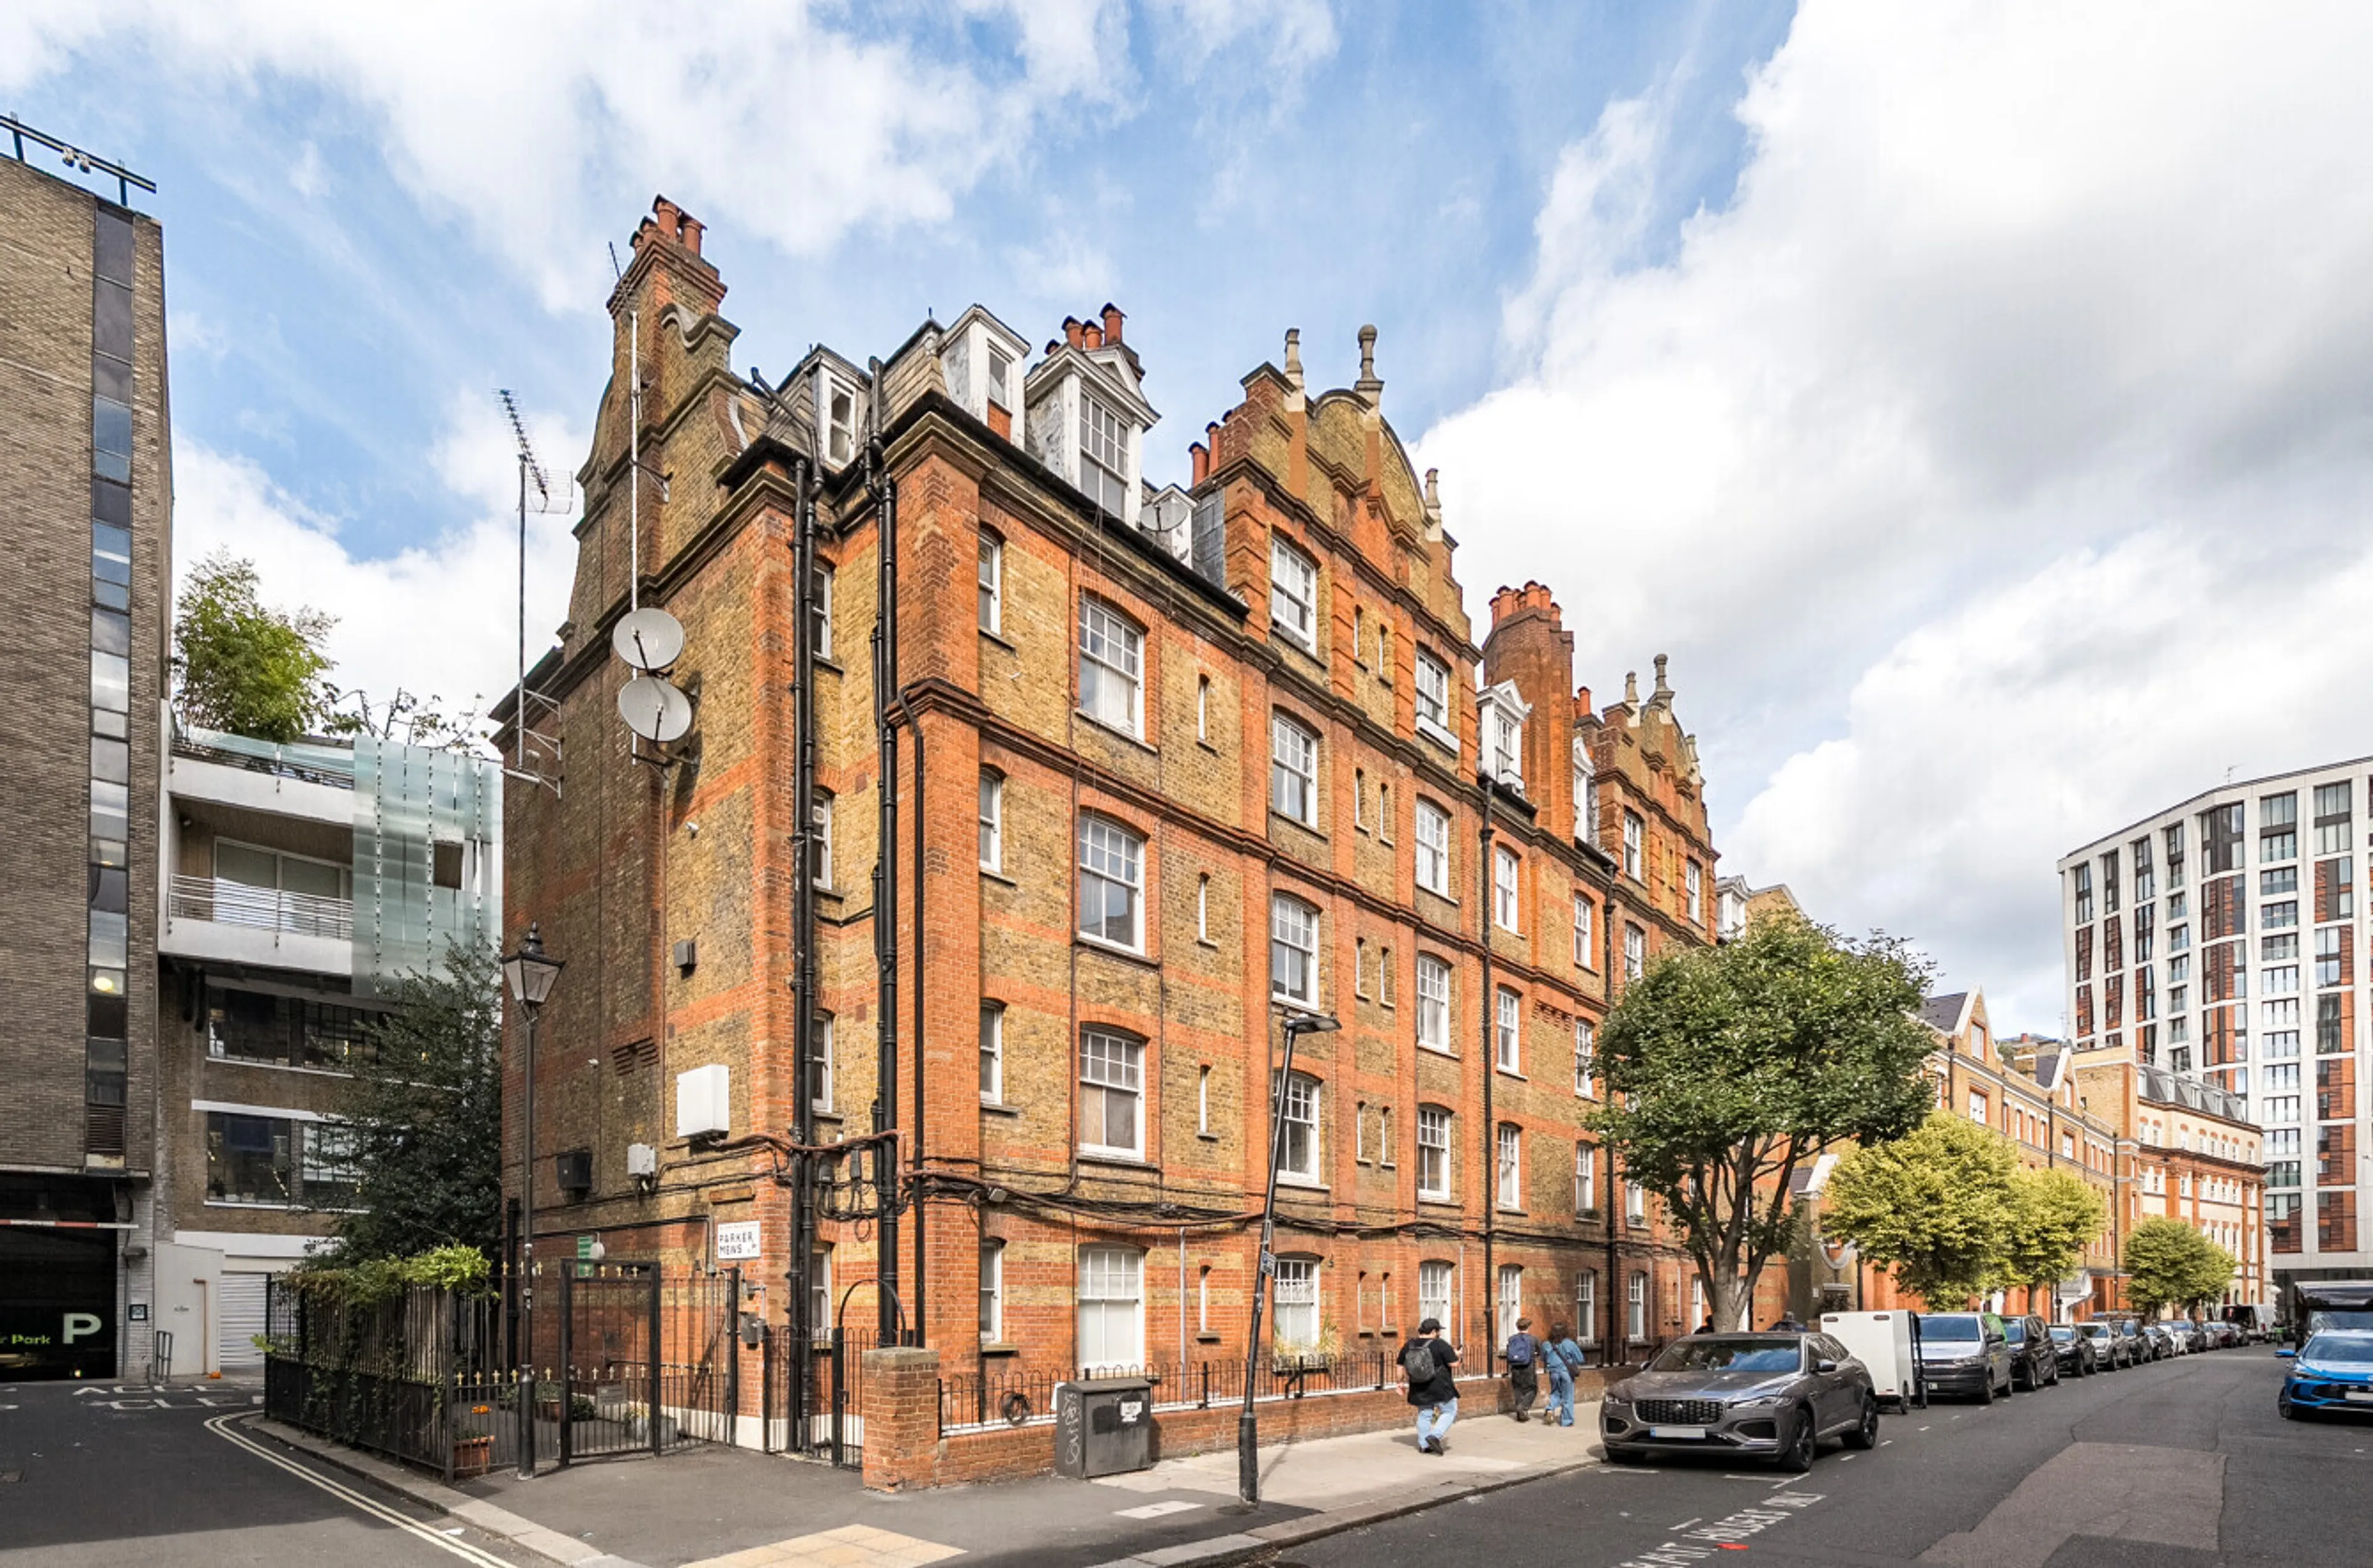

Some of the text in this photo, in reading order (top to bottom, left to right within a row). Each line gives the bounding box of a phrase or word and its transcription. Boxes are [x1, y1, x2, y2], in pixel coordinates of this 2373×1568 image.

[719, 1231, 754, 1242] PARKER
[62, 1312, 102, 1344] P
[12, 1333, 51, 1344] Park
